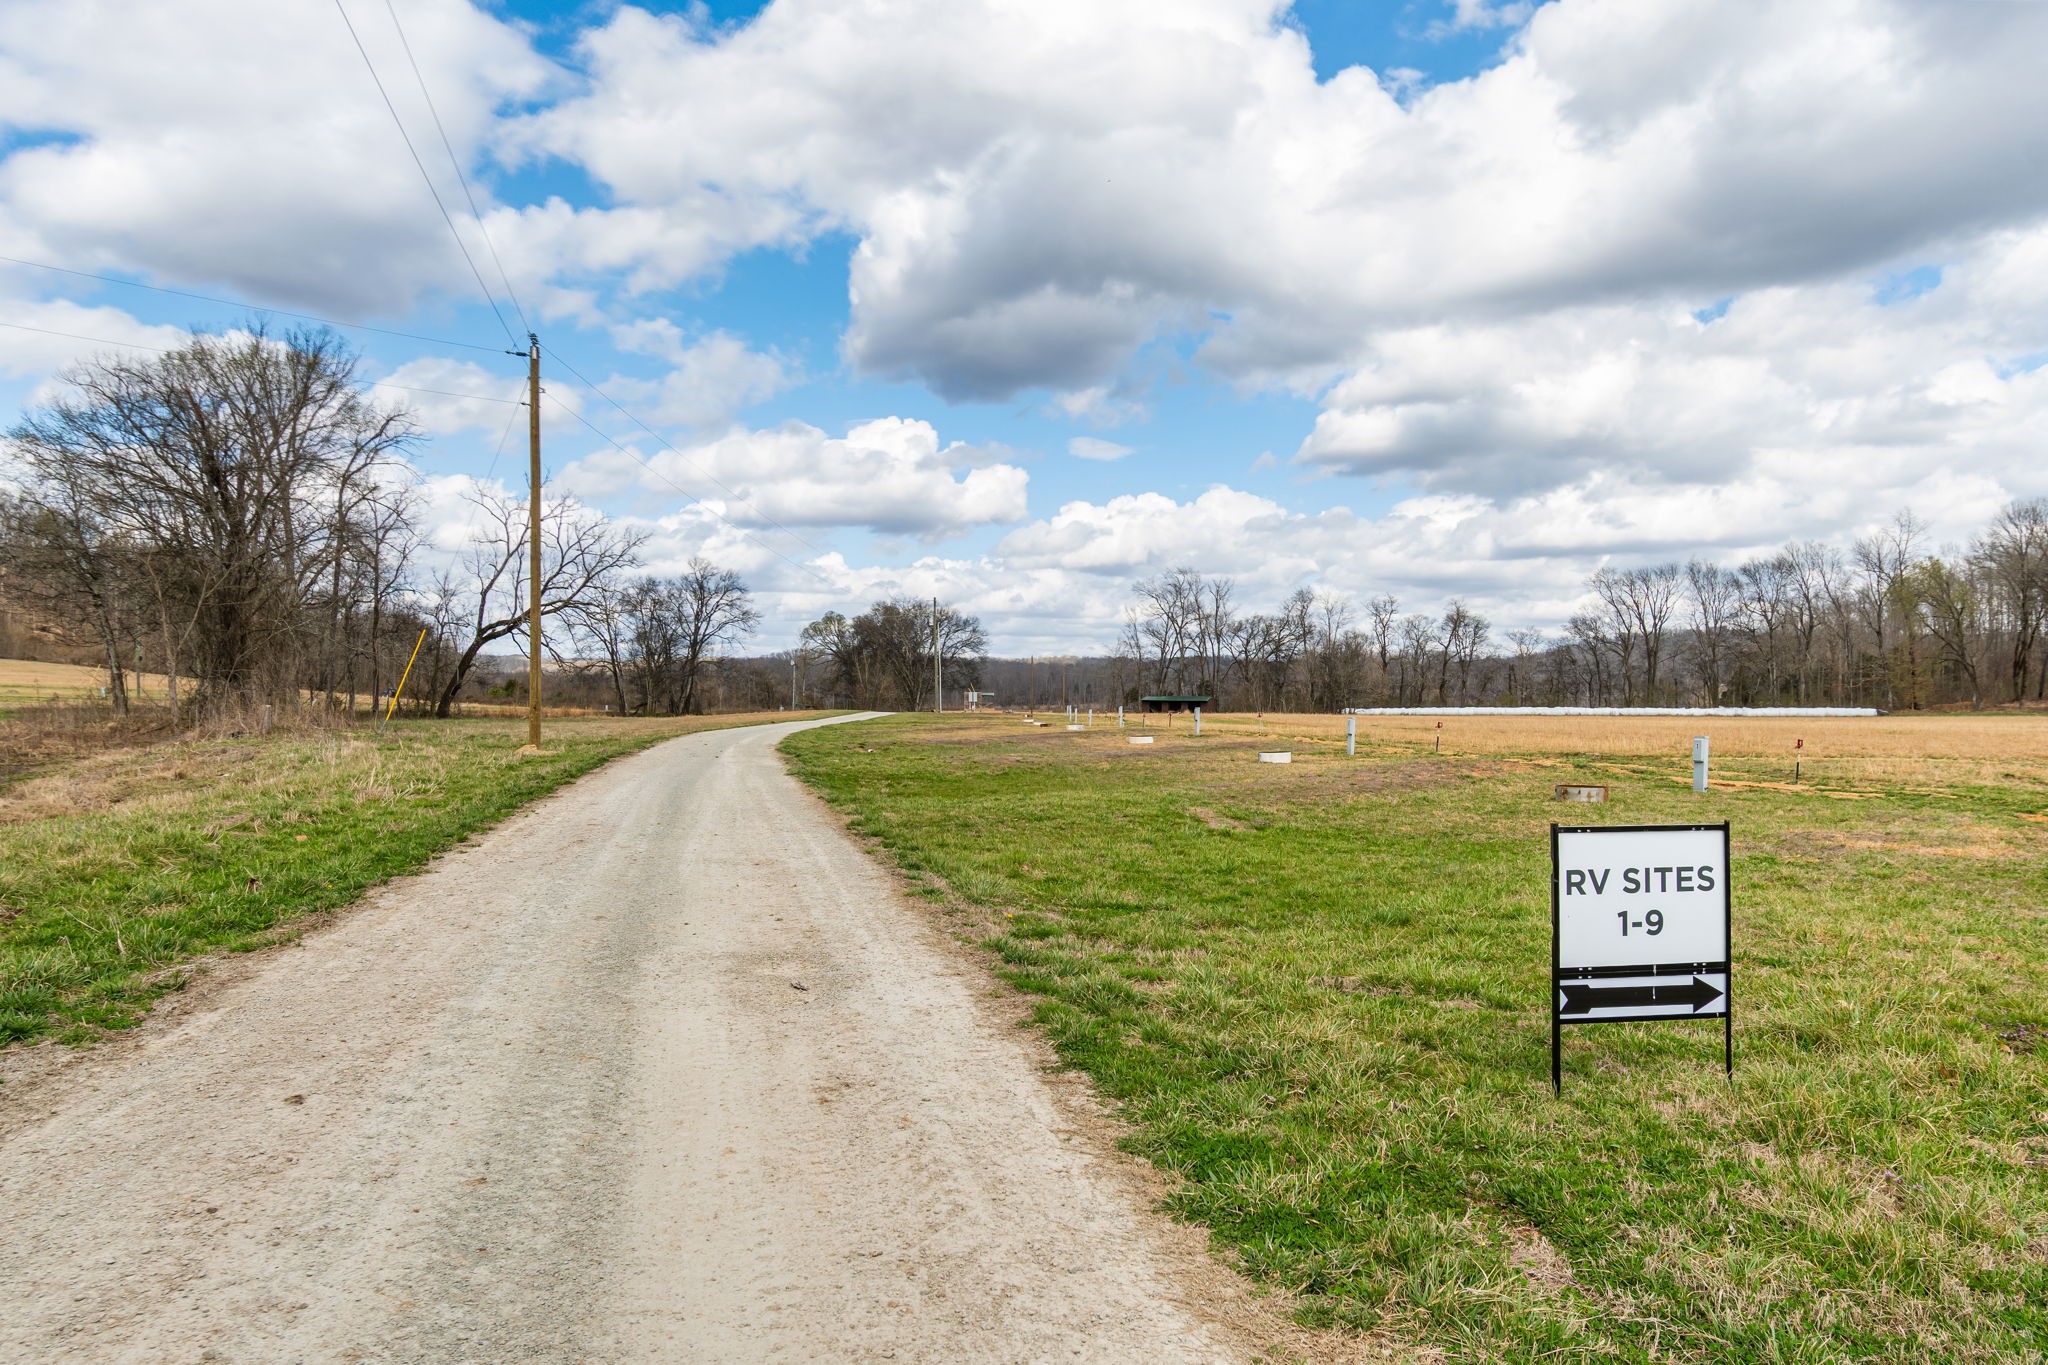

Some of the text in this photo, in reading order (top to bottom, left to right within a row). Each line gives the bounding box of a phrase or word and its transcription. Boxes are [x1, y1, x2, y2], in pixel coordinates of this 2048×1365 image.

[1566, 865, 1715, 896] RV SITES
[1617, 909, 1664, 937] 1-9
